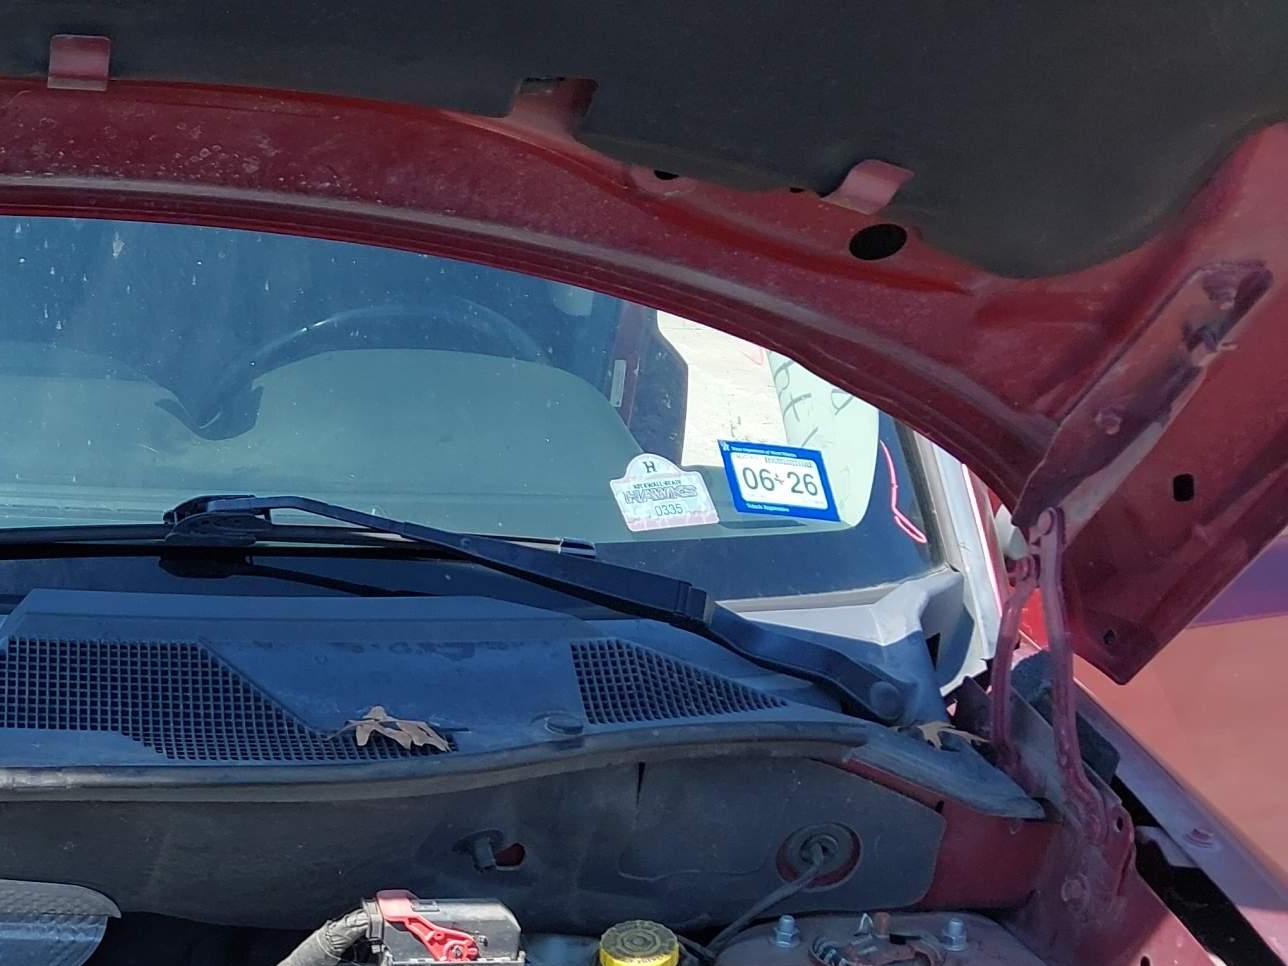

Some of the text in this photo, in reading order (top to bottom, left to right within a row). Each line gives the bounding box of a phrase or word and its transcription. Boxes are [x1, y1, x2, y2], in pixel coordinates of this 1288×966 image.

[642, 461, 658, 473] H
[742, 466, 819, 497] 06 26
[654, 503, 684, 517] 0335
